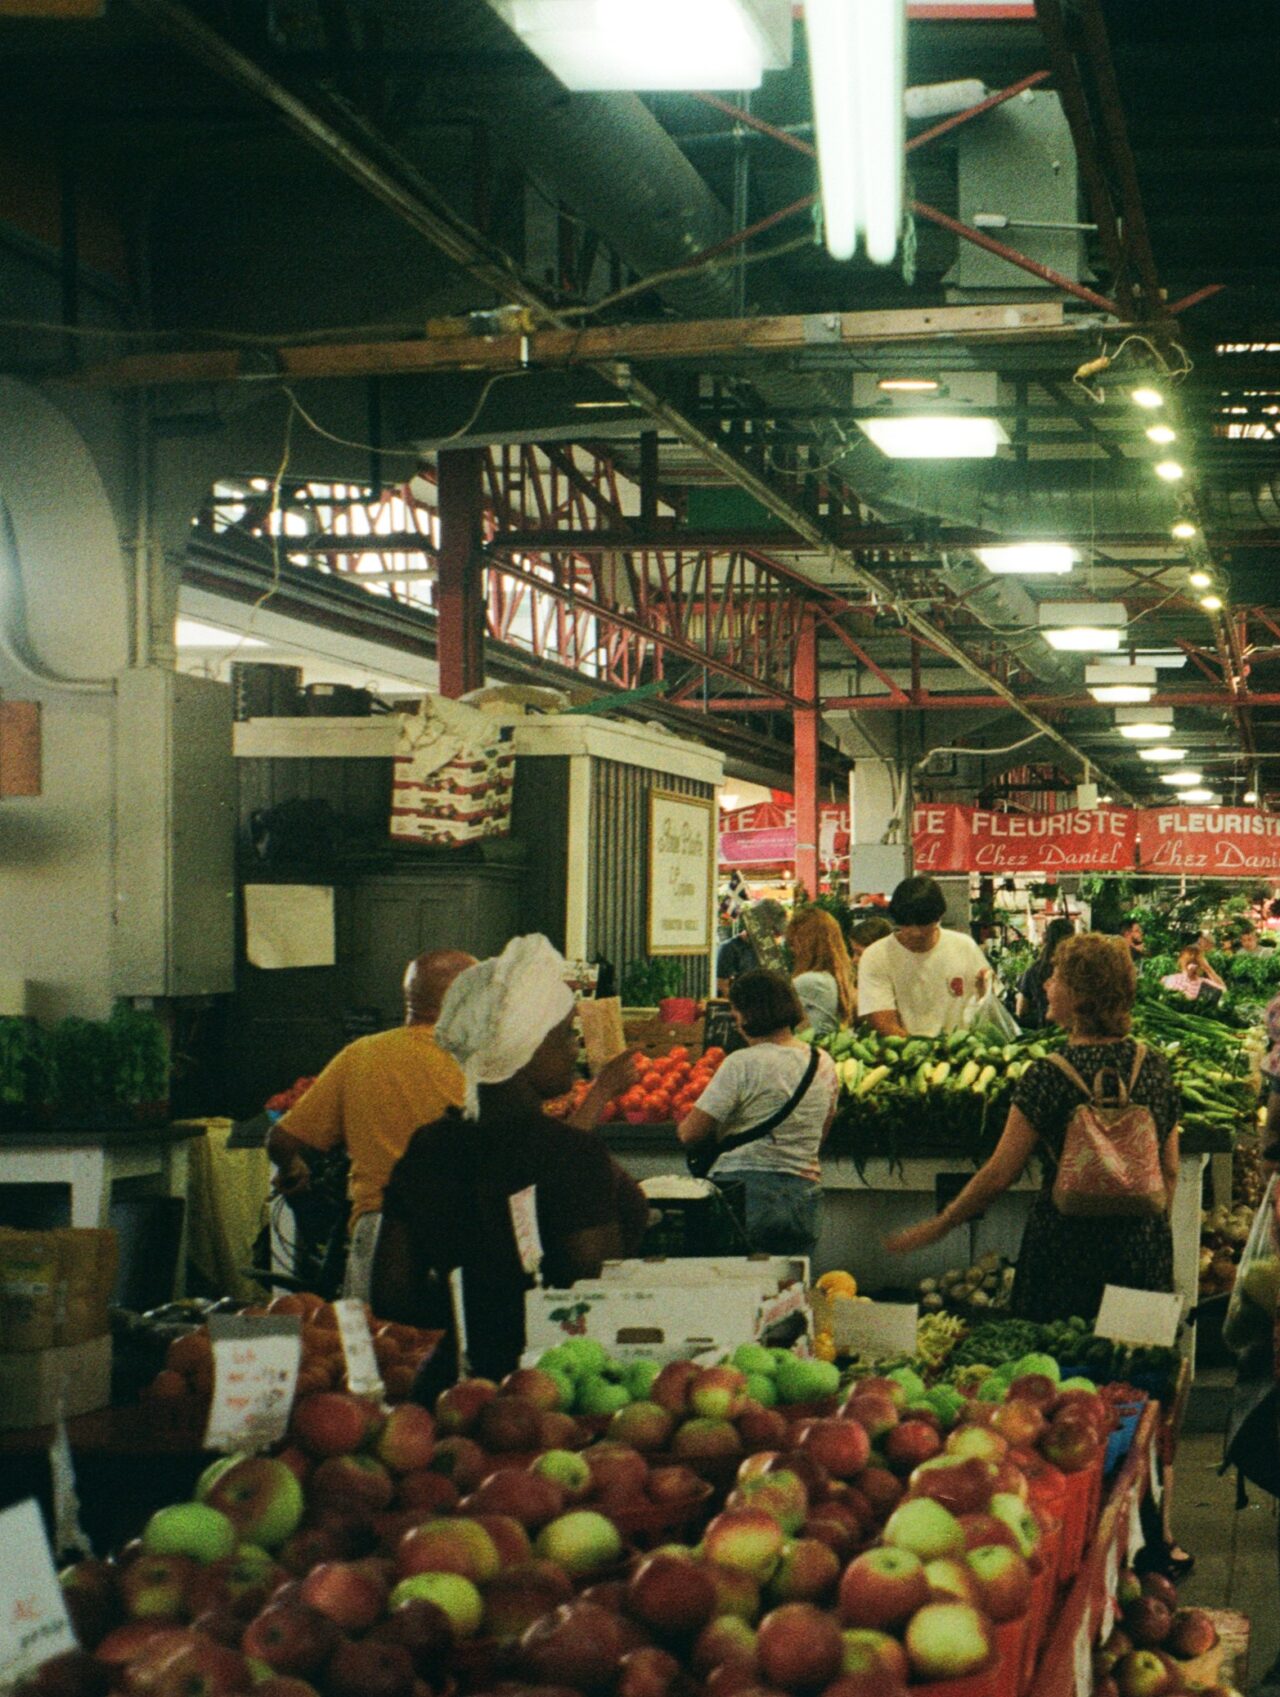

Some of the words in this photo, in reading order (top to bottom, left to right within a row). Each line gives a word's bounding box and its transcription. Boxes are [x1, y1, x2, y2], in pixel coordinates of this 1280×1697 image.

[971, 810, 1128, 838] FLEURISTE
[975, 843, 1029, 867] Chez
[1038, 843, 1123, 866] Daniel
[1152, 840, 1208, 868] Chez
